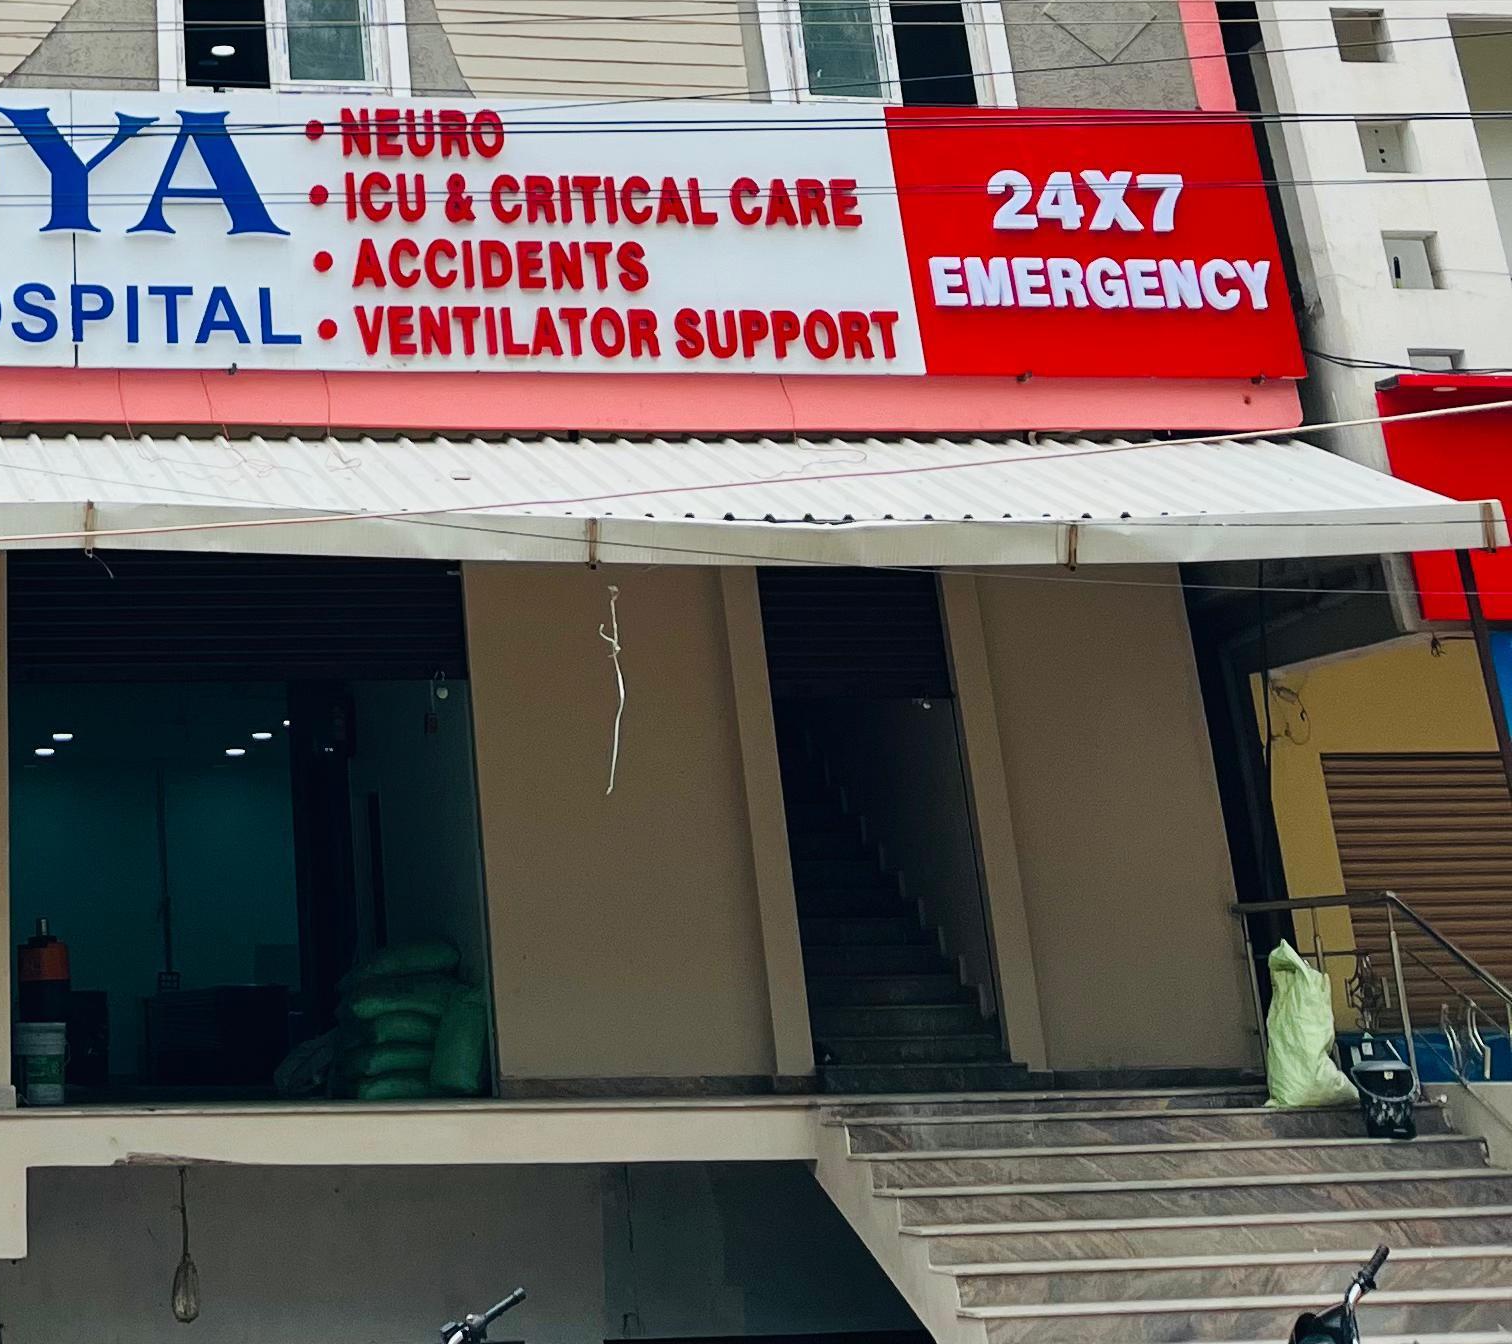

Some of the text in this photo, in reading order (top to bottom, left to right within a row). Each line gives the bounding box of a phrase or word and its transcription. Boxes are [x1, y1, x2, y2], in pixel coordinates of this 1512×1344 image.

[340, 108, 505, 159] NEURO
[345, 172, 864, 228] ICU & CRITICAL CARE
[351, 238, 649, 292] ACCIDENTS
[928, 256, 1271, 311] EMERGENCY
[354, 305, 900, 361] VENTILATOR SUPPORT
